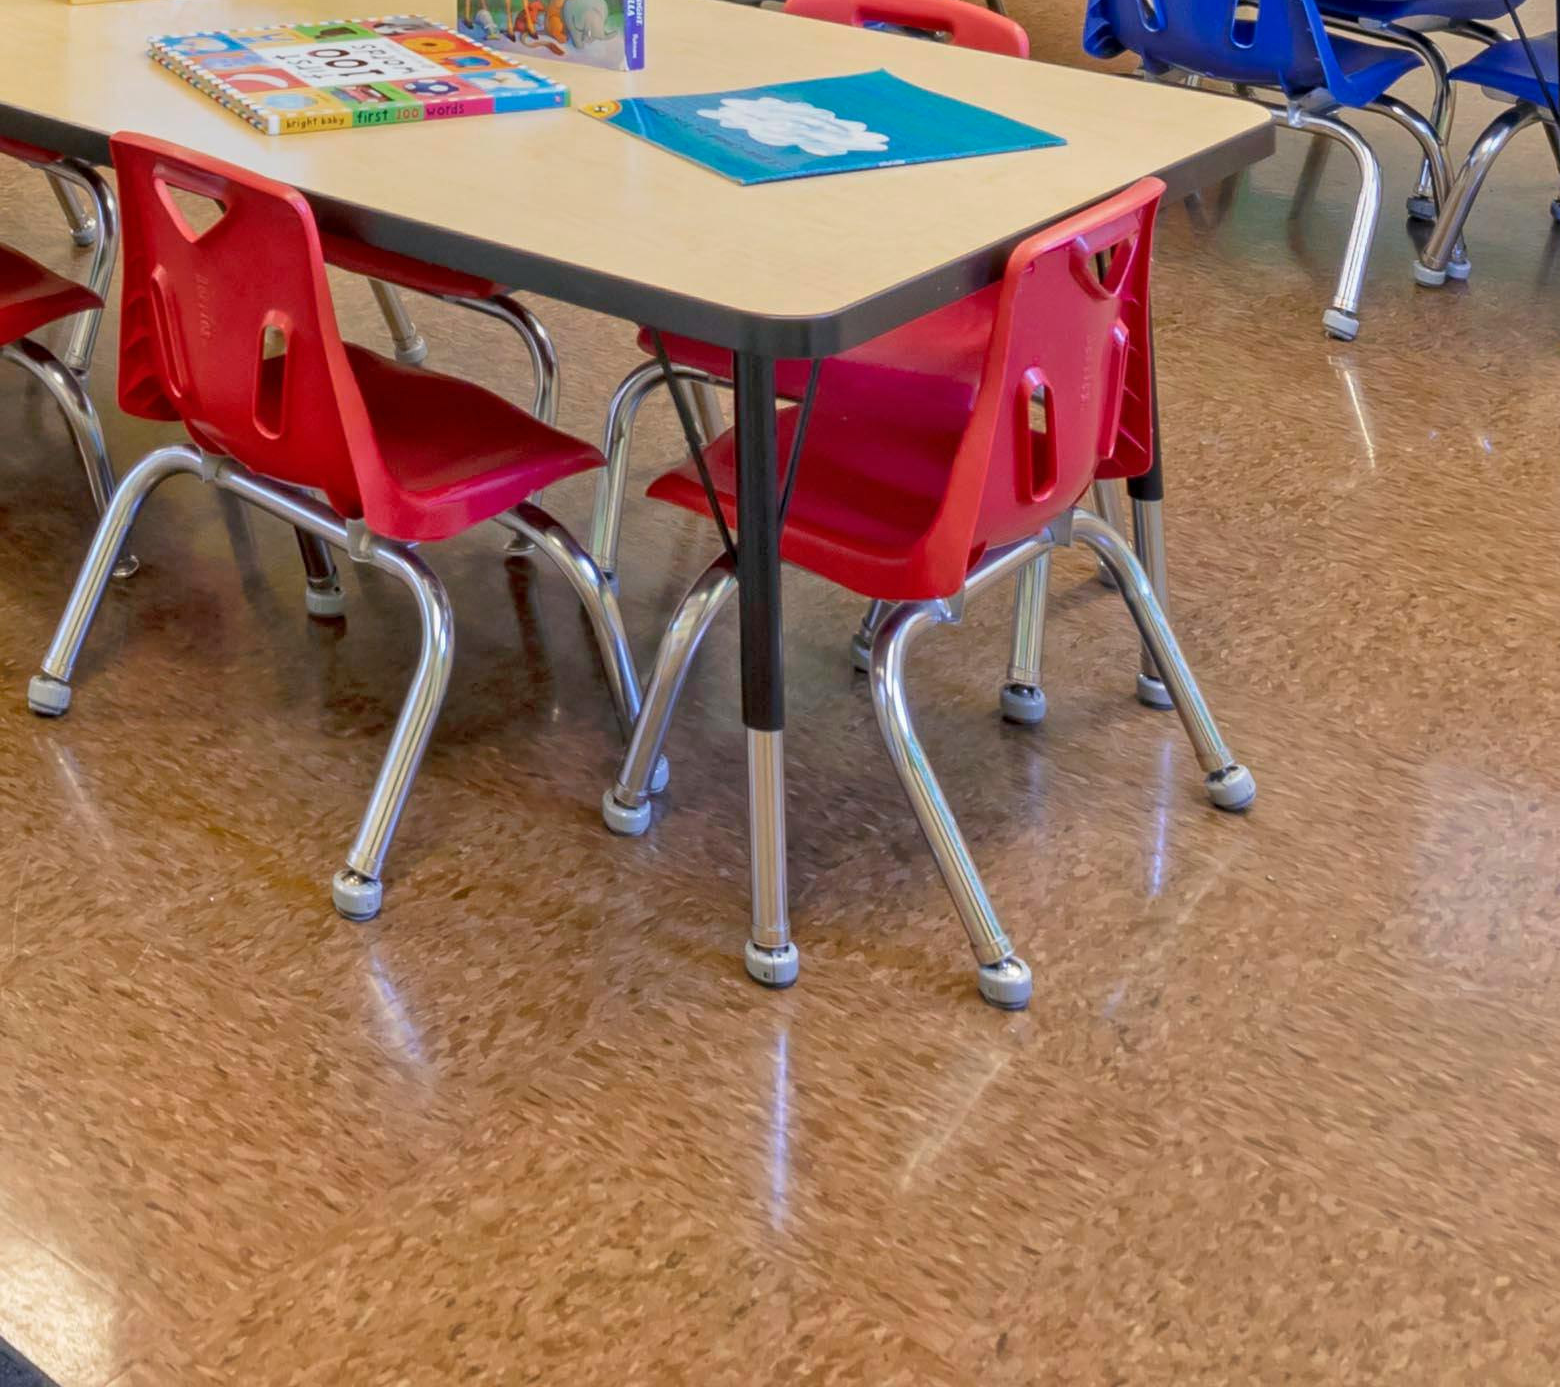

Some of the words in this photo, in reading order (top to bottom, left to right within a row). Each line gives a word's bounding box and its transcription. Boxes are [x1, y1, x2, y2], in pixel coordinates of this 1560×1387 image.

[307, 48, 385, 77] 100
[286, 116, 318, 130] bright
[321, 114, 345, 127] baby
[356, 109, 389, 125] first
[396, 107, 420, 121] 100
[426, 103, 464, 117] words
